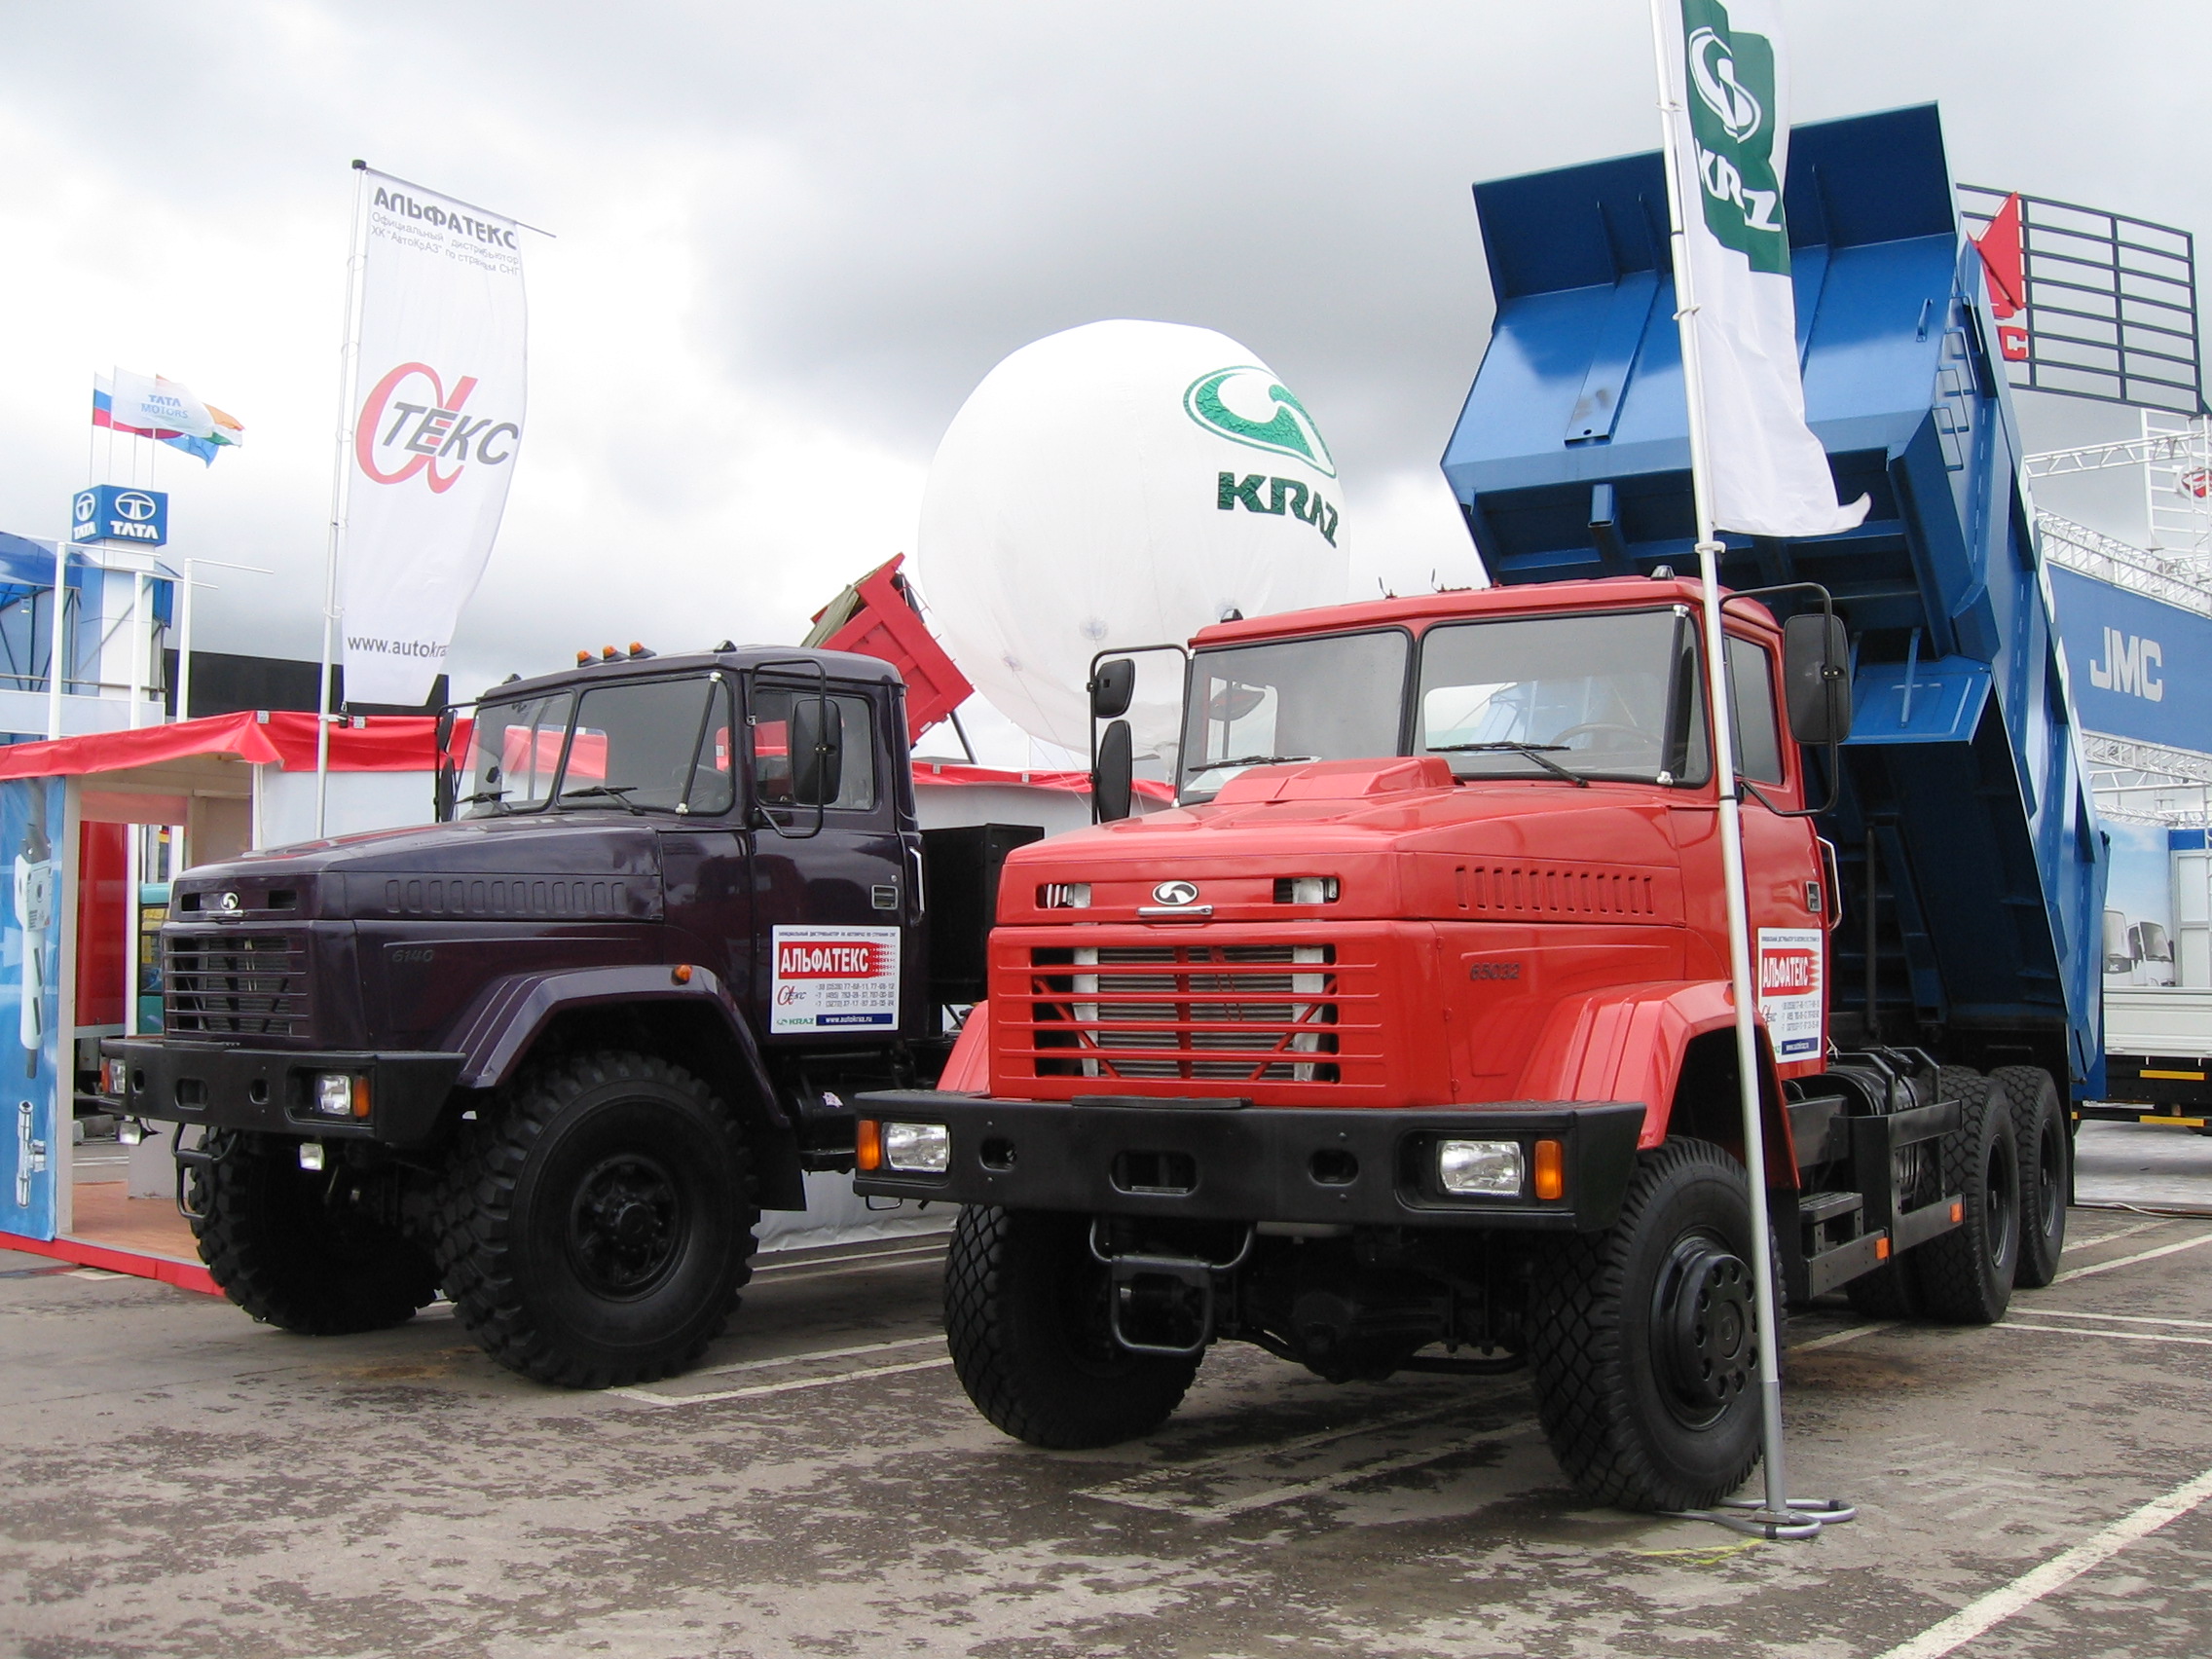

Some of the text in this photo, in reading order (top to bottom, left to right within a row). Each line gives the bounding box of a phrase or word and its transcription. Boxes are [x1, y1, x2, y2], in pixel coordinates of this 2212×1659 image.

[372, 211, 444, 241] Официальный
[373, 186, 517, 250] АЛЬФАТЕКС
[141, 403, 189, 419] MOTORS
[148, 394, 181, 407] TATA
[382, 401, 519, 465] ТЕКС
[73, 521, 96, 540] TATA
[110, 520, 159, 539] TATA
[2089, 626, 2162, 702] JMC
[780, 947, 869, 973] АЛЬФАТЕКС
[1762, 956, 1809, 988] АЛЬФАТЕКС
